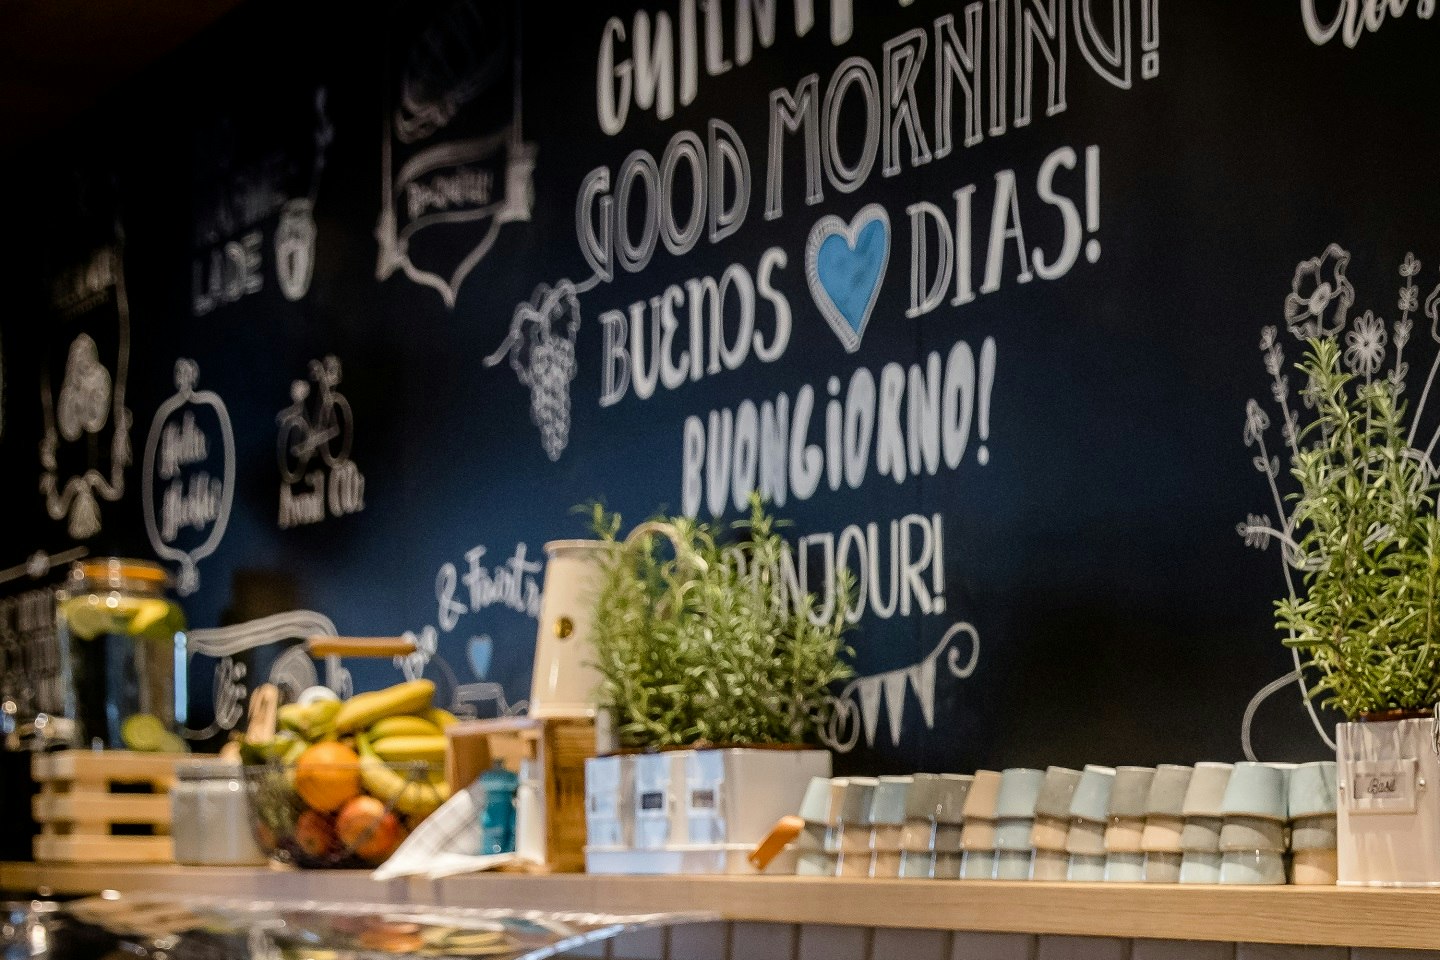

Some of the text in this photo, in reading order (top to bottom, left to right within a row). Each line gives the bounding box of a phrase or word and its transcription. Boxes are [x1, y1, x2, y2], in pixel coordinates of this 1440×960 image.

[576, 0, 1160, 282] GOOD MORNING!
[600, 146, 1101, 407] BUENOS DIAS!
